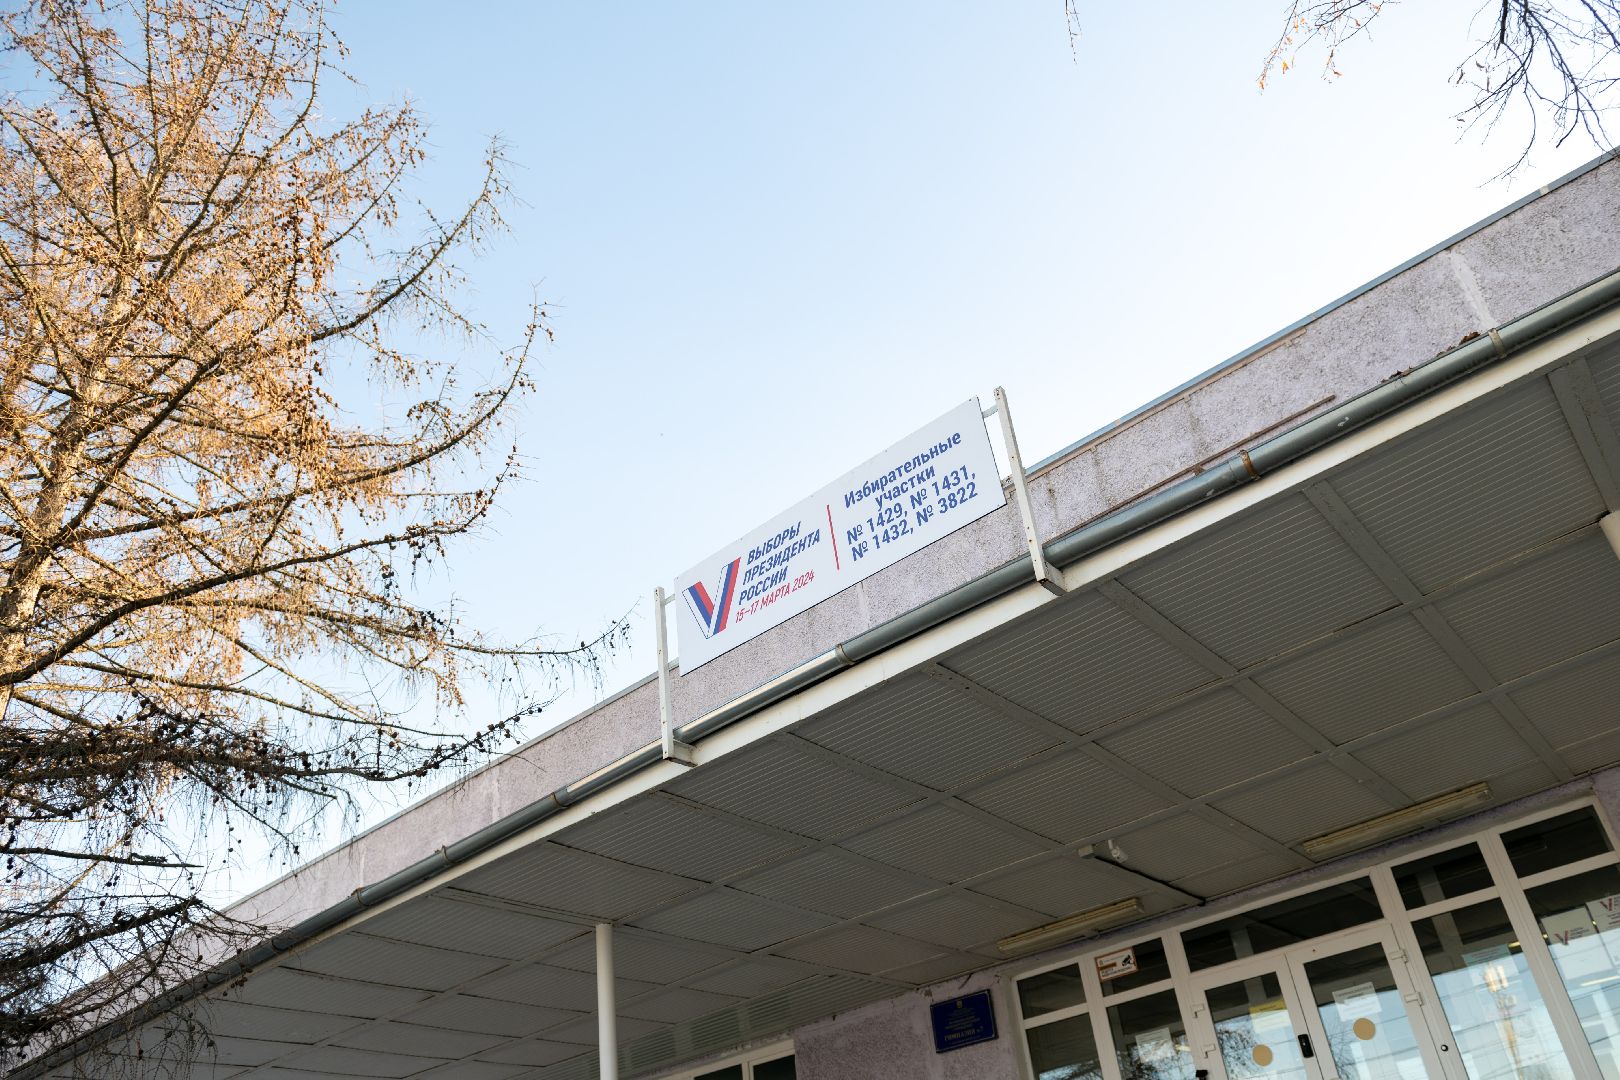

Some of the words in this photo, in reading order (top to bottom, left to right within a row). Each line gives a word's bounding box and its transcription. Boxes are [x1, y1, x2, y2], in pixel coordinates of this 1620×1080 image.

[844, 432, 962, 508] Избирательные
[875, 465, 936, 512] участки
[846, 524, 863, 545] №
[866, 502, 908, 533] 1429,
[909, 488, 928, 509] №
[932, 464, 976, 496] 1431,
[851, 540, 869, 561] №
[872, 519, 914, 549] 1432,
[916, 504, 934, 526] №
[937, 481, 978, 514] 3822
[742, 529, 820, 585] ПРЕЗИДЕНТА
[747, 521, 802, 565] ВЫБОРЫ
[739, 565, 789, 605] РОССИИ
[760, 582, 790, 610] МАРТА
[791, 569, 815, 592] 2024
